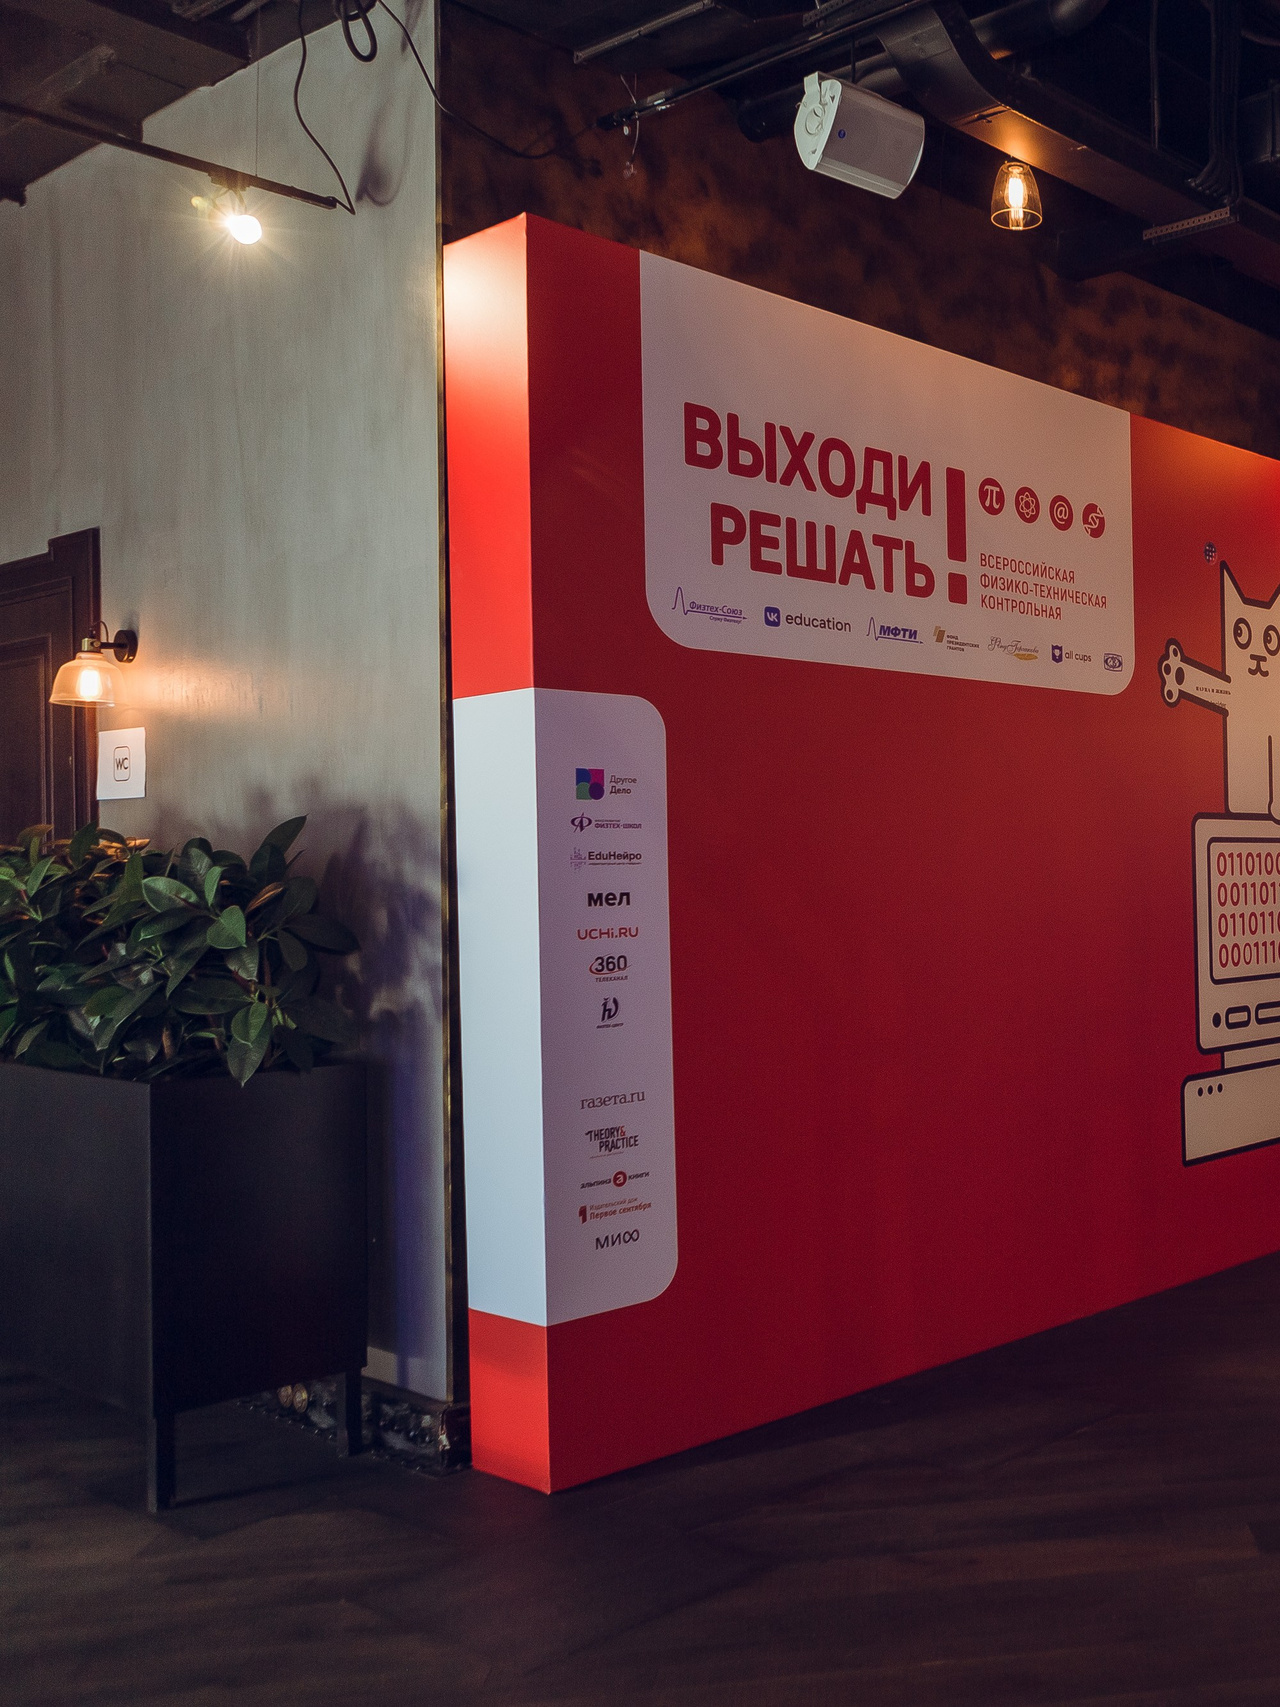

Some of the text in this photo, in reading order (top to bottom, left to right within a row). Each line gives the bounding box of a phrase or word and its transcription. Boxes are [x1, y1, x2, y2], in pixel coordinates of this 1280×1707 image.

[683, 401, 932, 521] ВЫХОДИ
[710, 502, 936, 599] РЕШАТЬ
[980, 552, 1075, 584] ВСЕРОССИЙСКАЯ
[980, 573, 1107, 609] ФИЗИКО-ТЕХНИЧЕСКАЯ
[689, 601, 743, 616] Физтех-Союз
[981, 594, 1062, 621] КОНТРОЛЬНАЯ
[785, 613, 852, 632] education
[879, 624, 918, 640] МФТИ
[1065, 650, 1092, 663] all cups
[115, 757, 129, 770] WC
[609, 775, 638, 785] Другое
[609, 785, 632, 795] Дело
[587, 892, 631, 907] мел
[577, 926, 639, 940] UCHi.RU
[594, 954, 628, 973] 360
[580, 1091, 646, 1110] газета.ru
[599, 1134, 639, 1152] PRACTICE
[590, 1202, 652, 1221] Первое сентября
